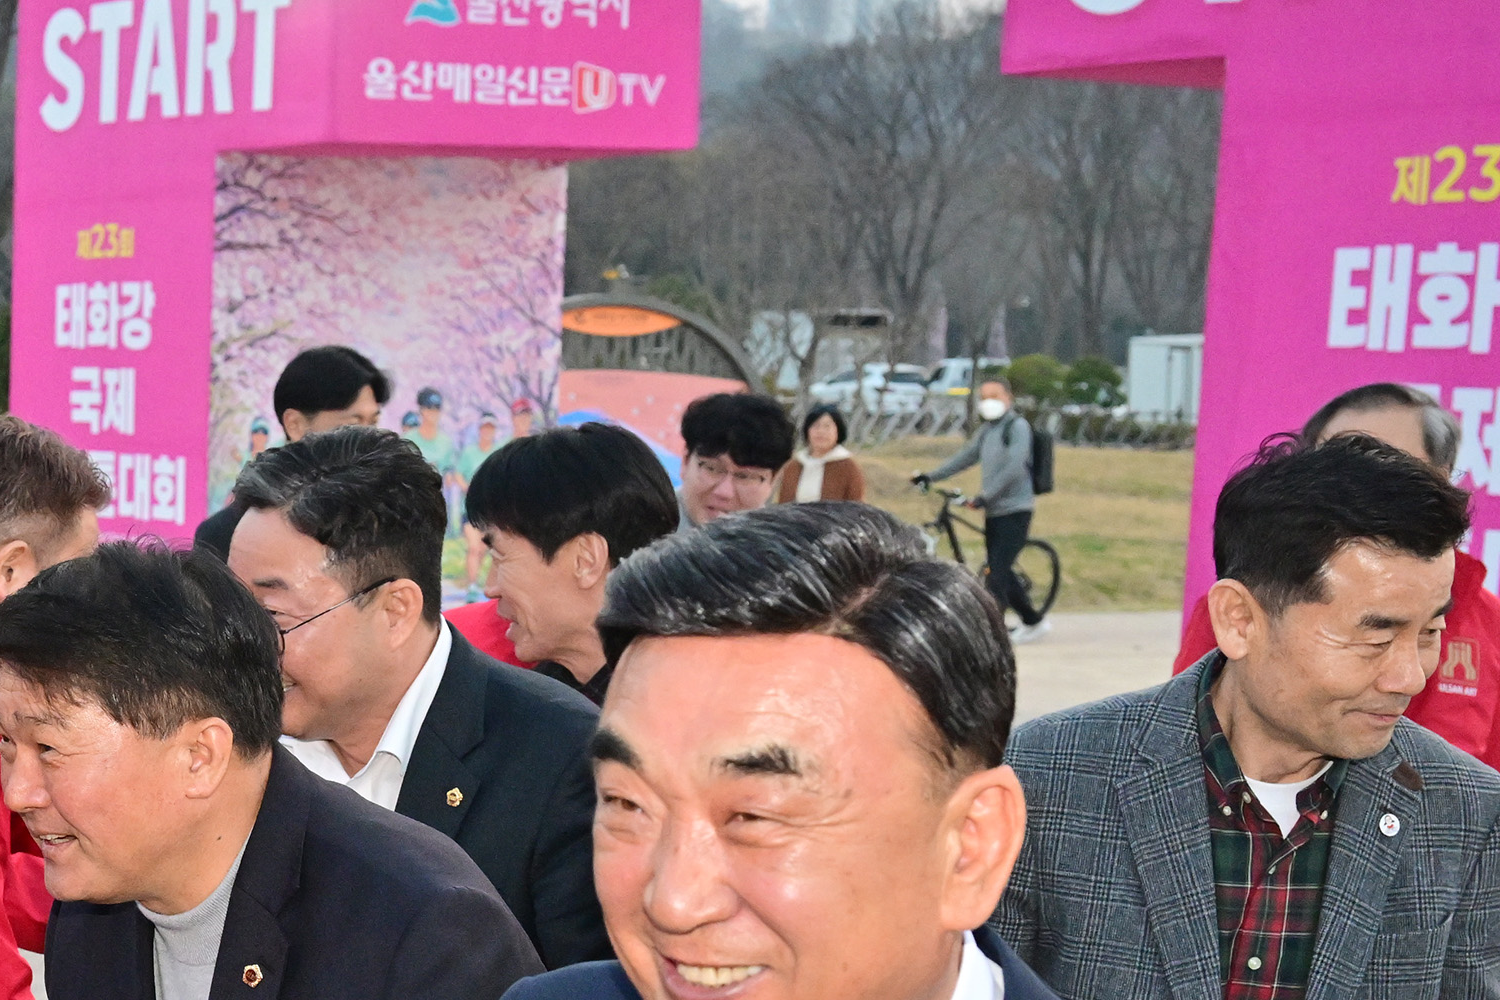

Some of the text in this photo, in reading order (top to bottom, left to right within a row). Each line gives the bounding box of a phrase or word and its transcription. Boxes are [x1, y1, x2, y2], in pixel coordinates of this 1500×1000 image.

[38, 0, 292, 133] START
[363, 57, 572, 106] 울산매일신문
[55, 280, 156, 351] 태화강
[68, 366, 136, 436] 국제
